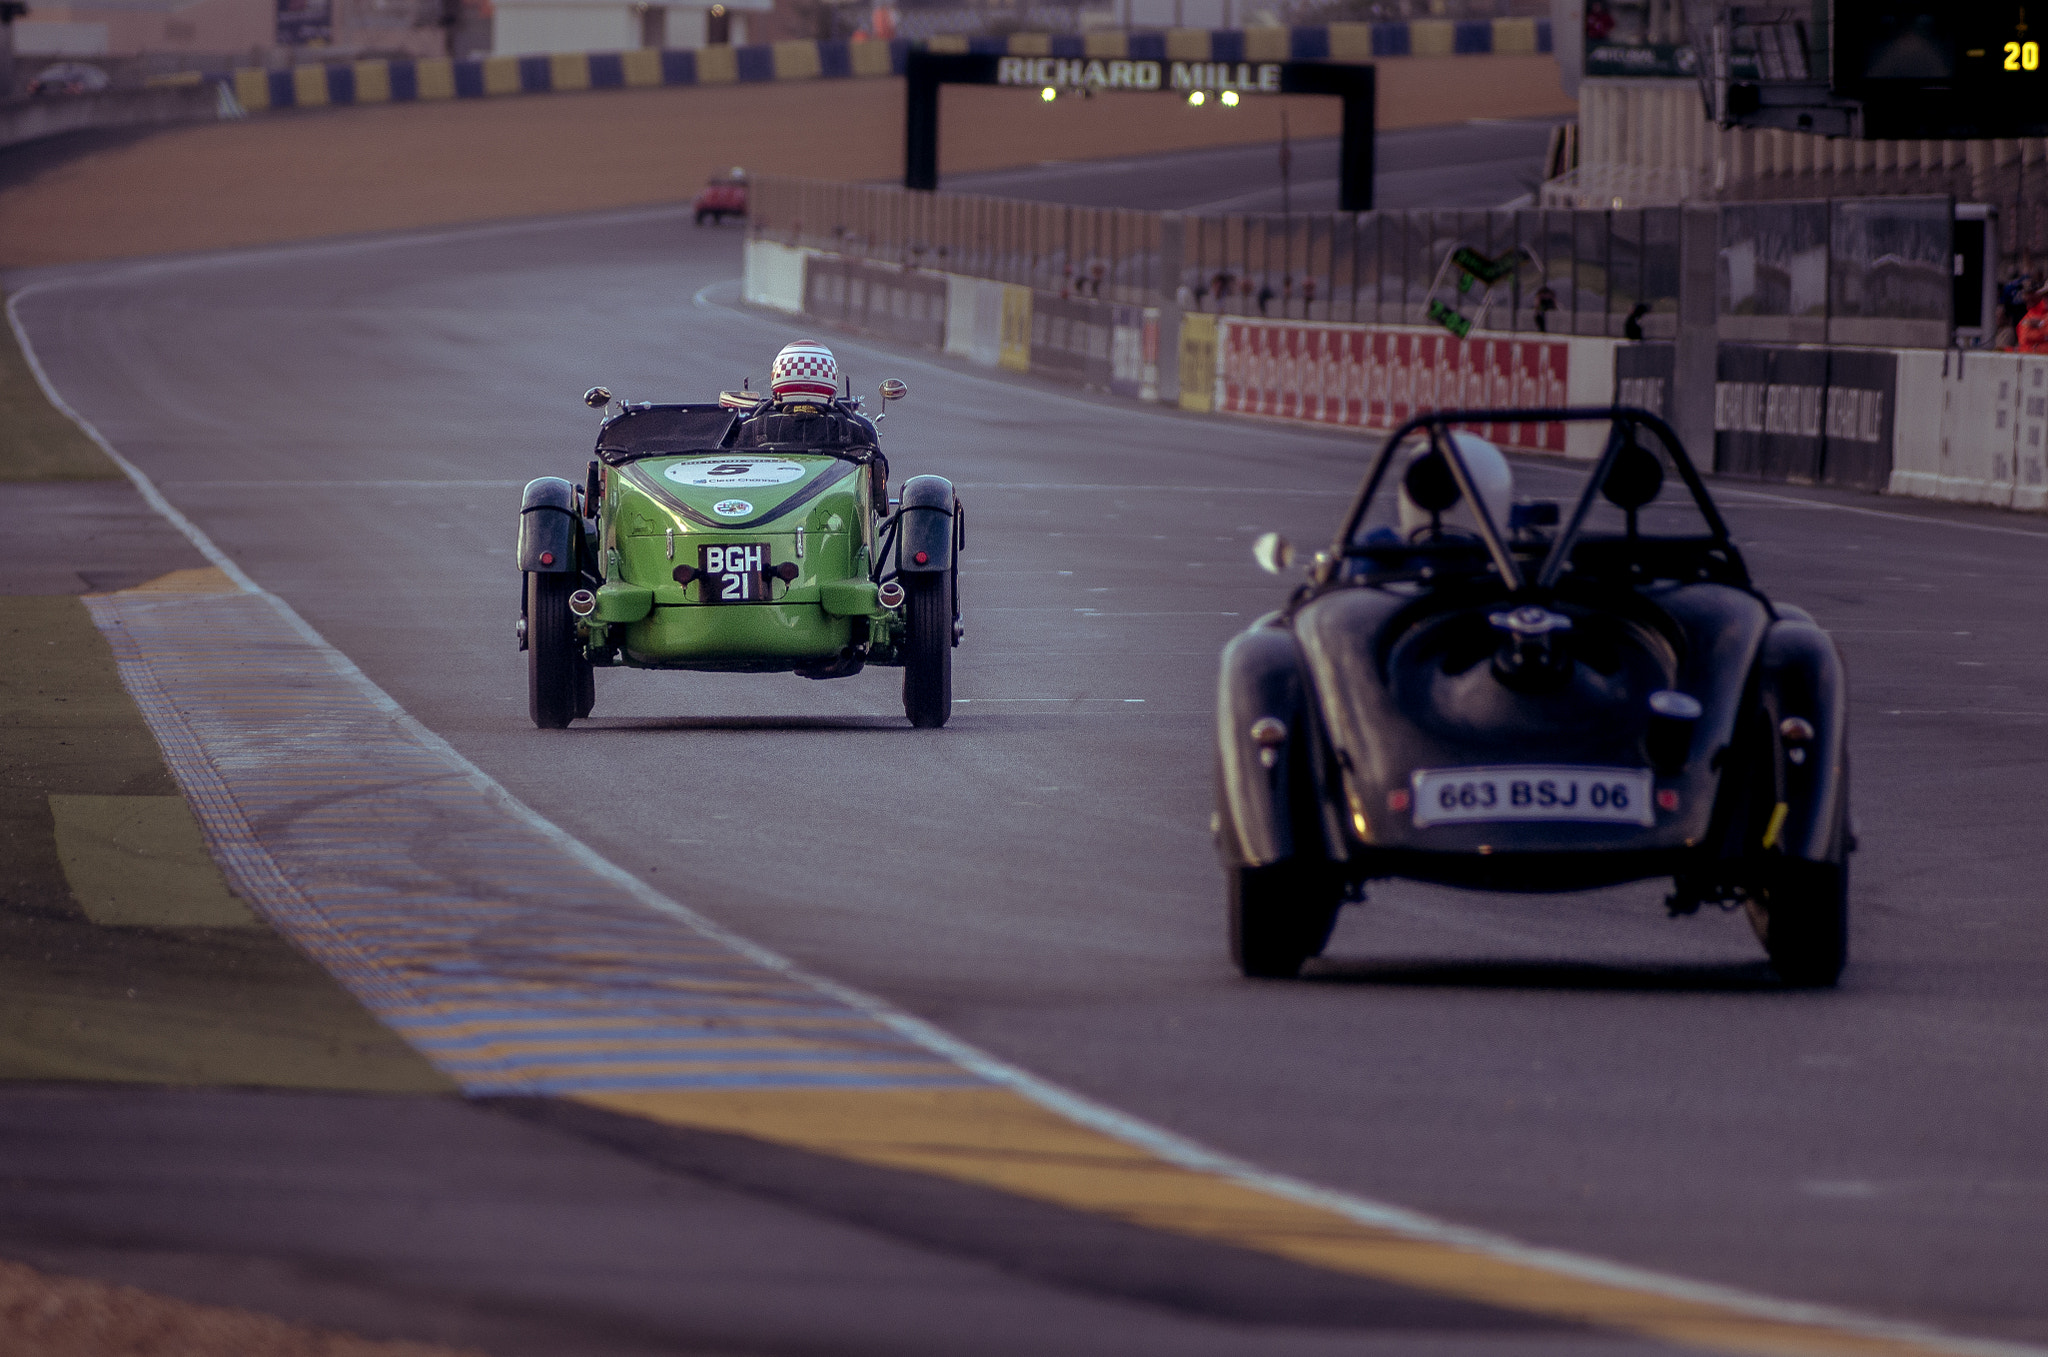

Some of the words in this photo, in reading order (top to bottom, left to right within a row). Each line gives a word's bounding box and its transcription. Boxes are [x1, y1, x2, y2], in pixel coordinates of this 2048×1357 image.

[2003, 41, 2040, 71] 20
[998, 57, 1162, 89] RICHARD
[1170, 61, 1282, 92] MILLE
[707, 464, 753, 475] 5
[706, 546, 762, 573] BGH
[721, 573, 749, 599] 21
[1439, 782, 1497, 809] 663
[1510, 780, 1578, 808] BSJ
[1589, 782, 1630, 809] 06
